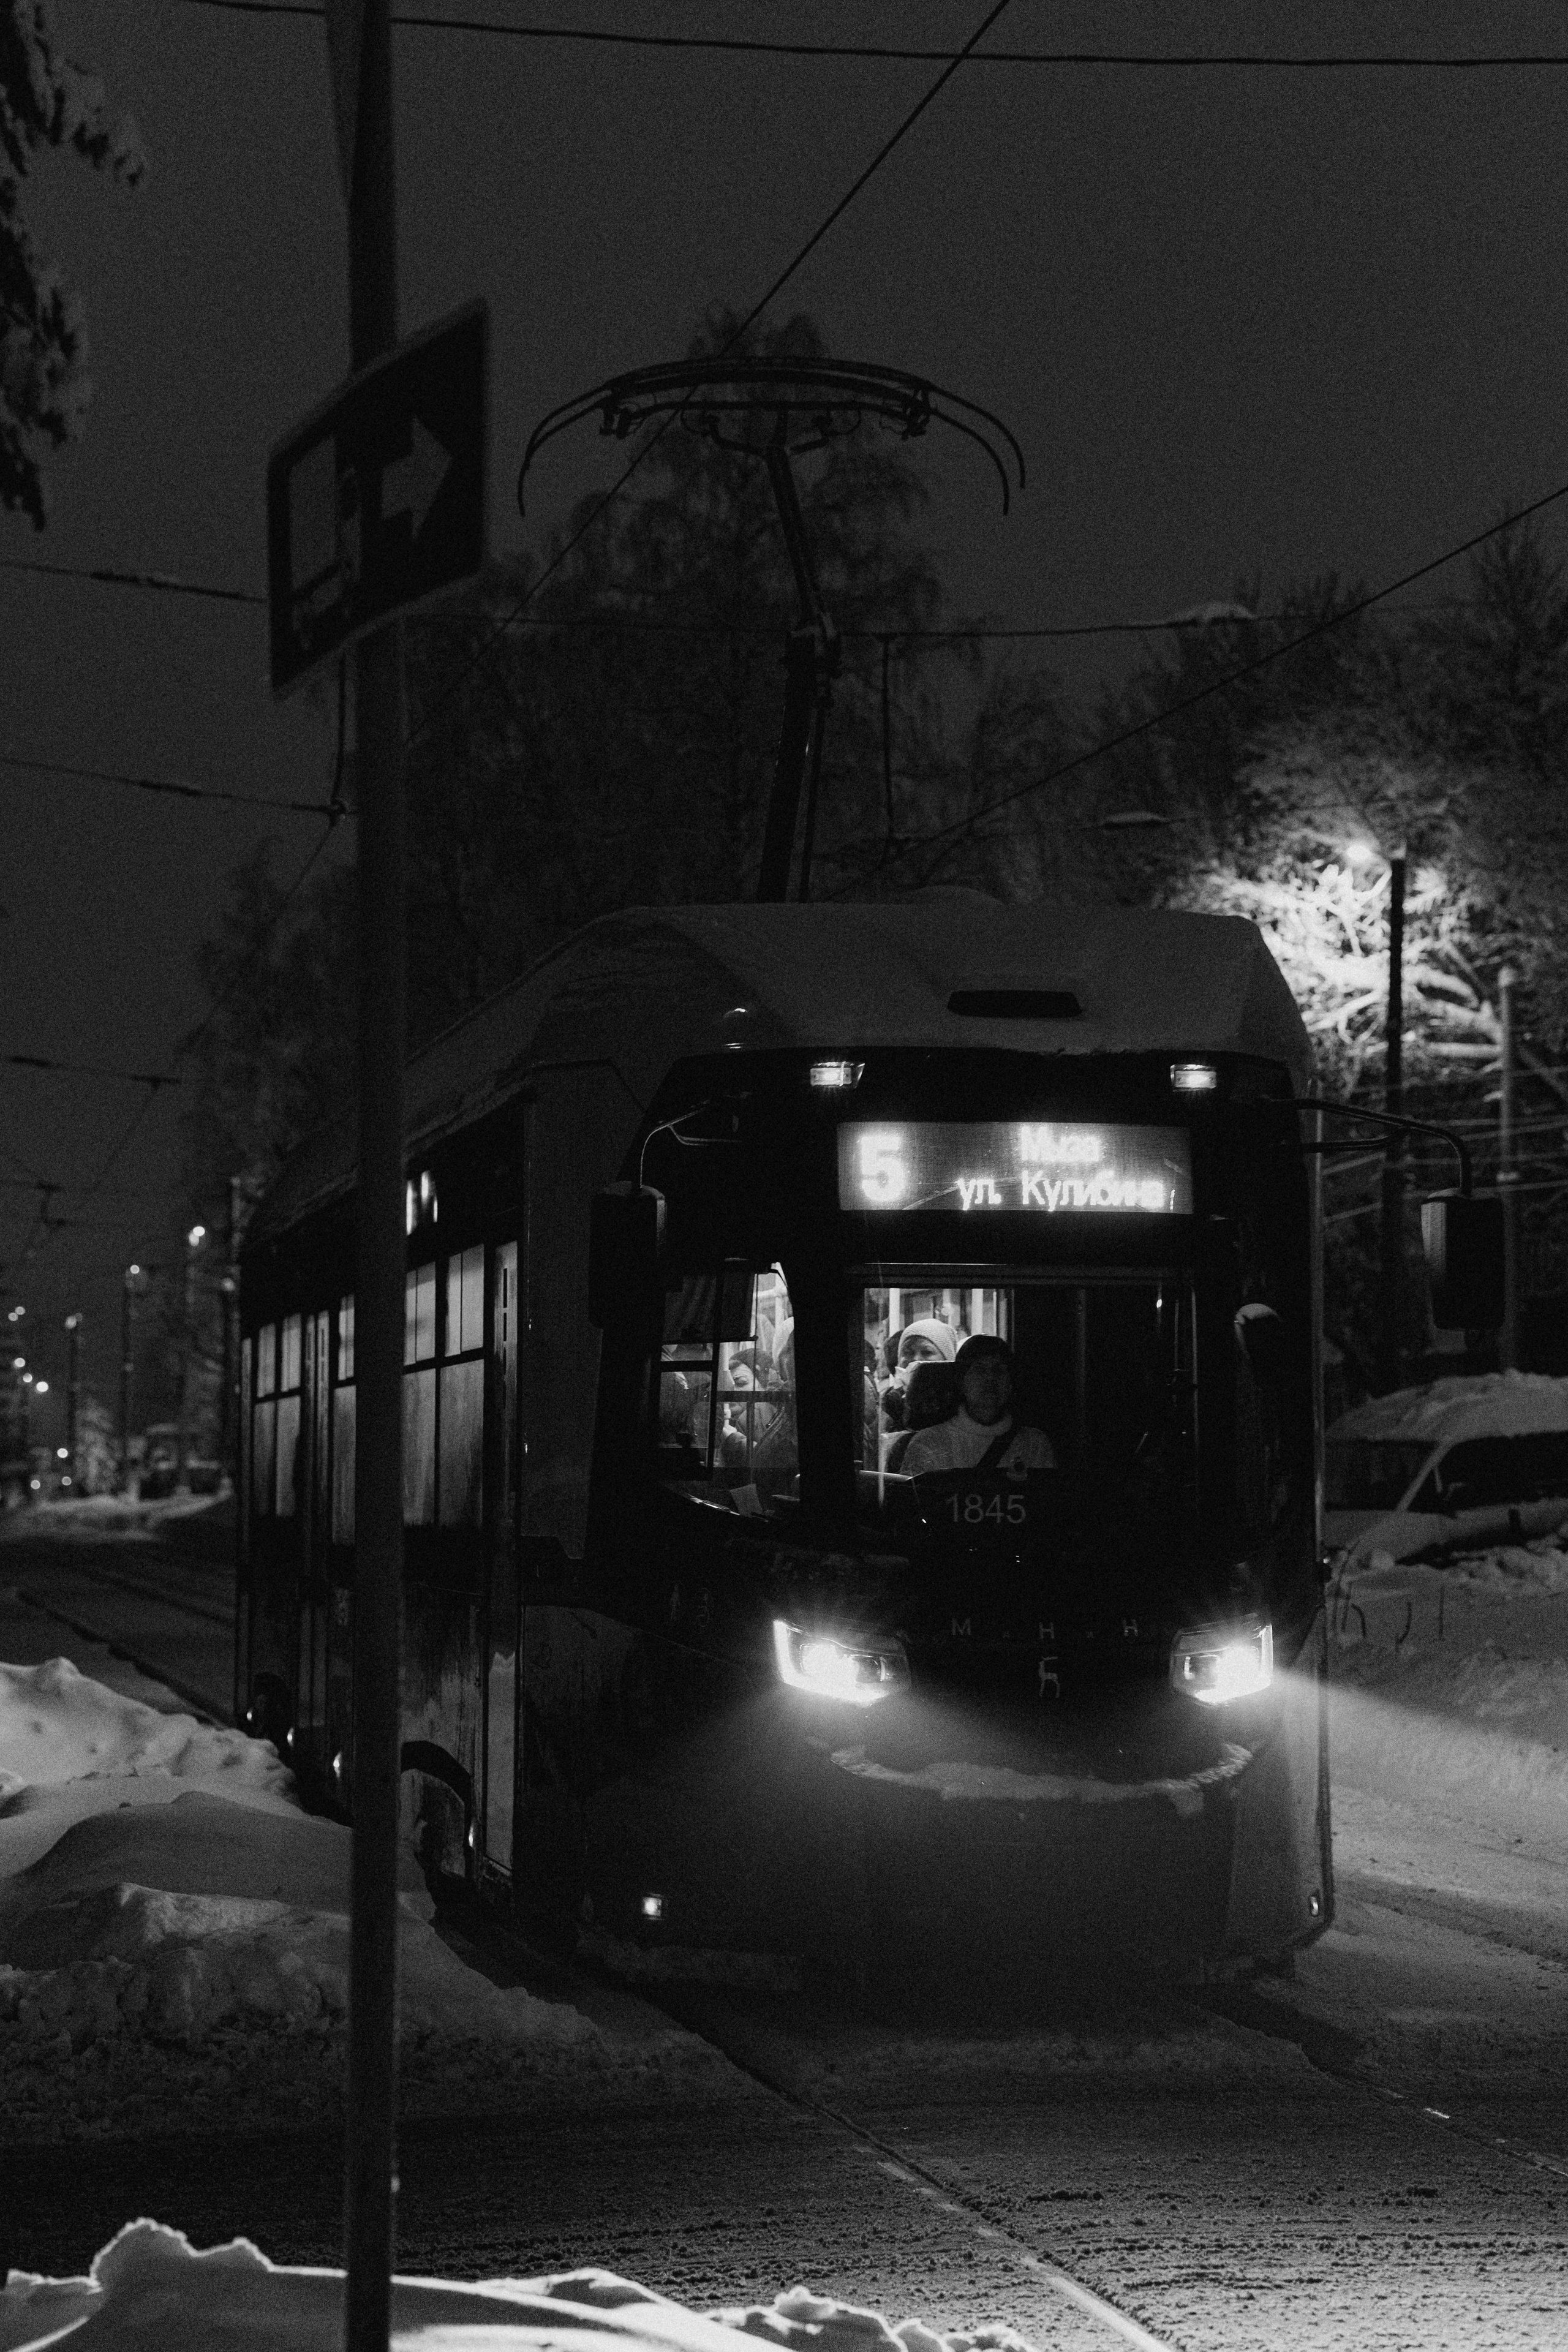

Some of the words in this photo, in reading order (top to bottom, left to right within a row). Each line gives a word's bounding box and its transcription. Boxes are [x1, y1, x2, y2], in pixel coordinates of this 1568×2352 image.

[860, 1134, 907, 1202] 5
[956, 1178, 1001, 1211] ул.
[946, 1493, 1027, 1524] 1845
